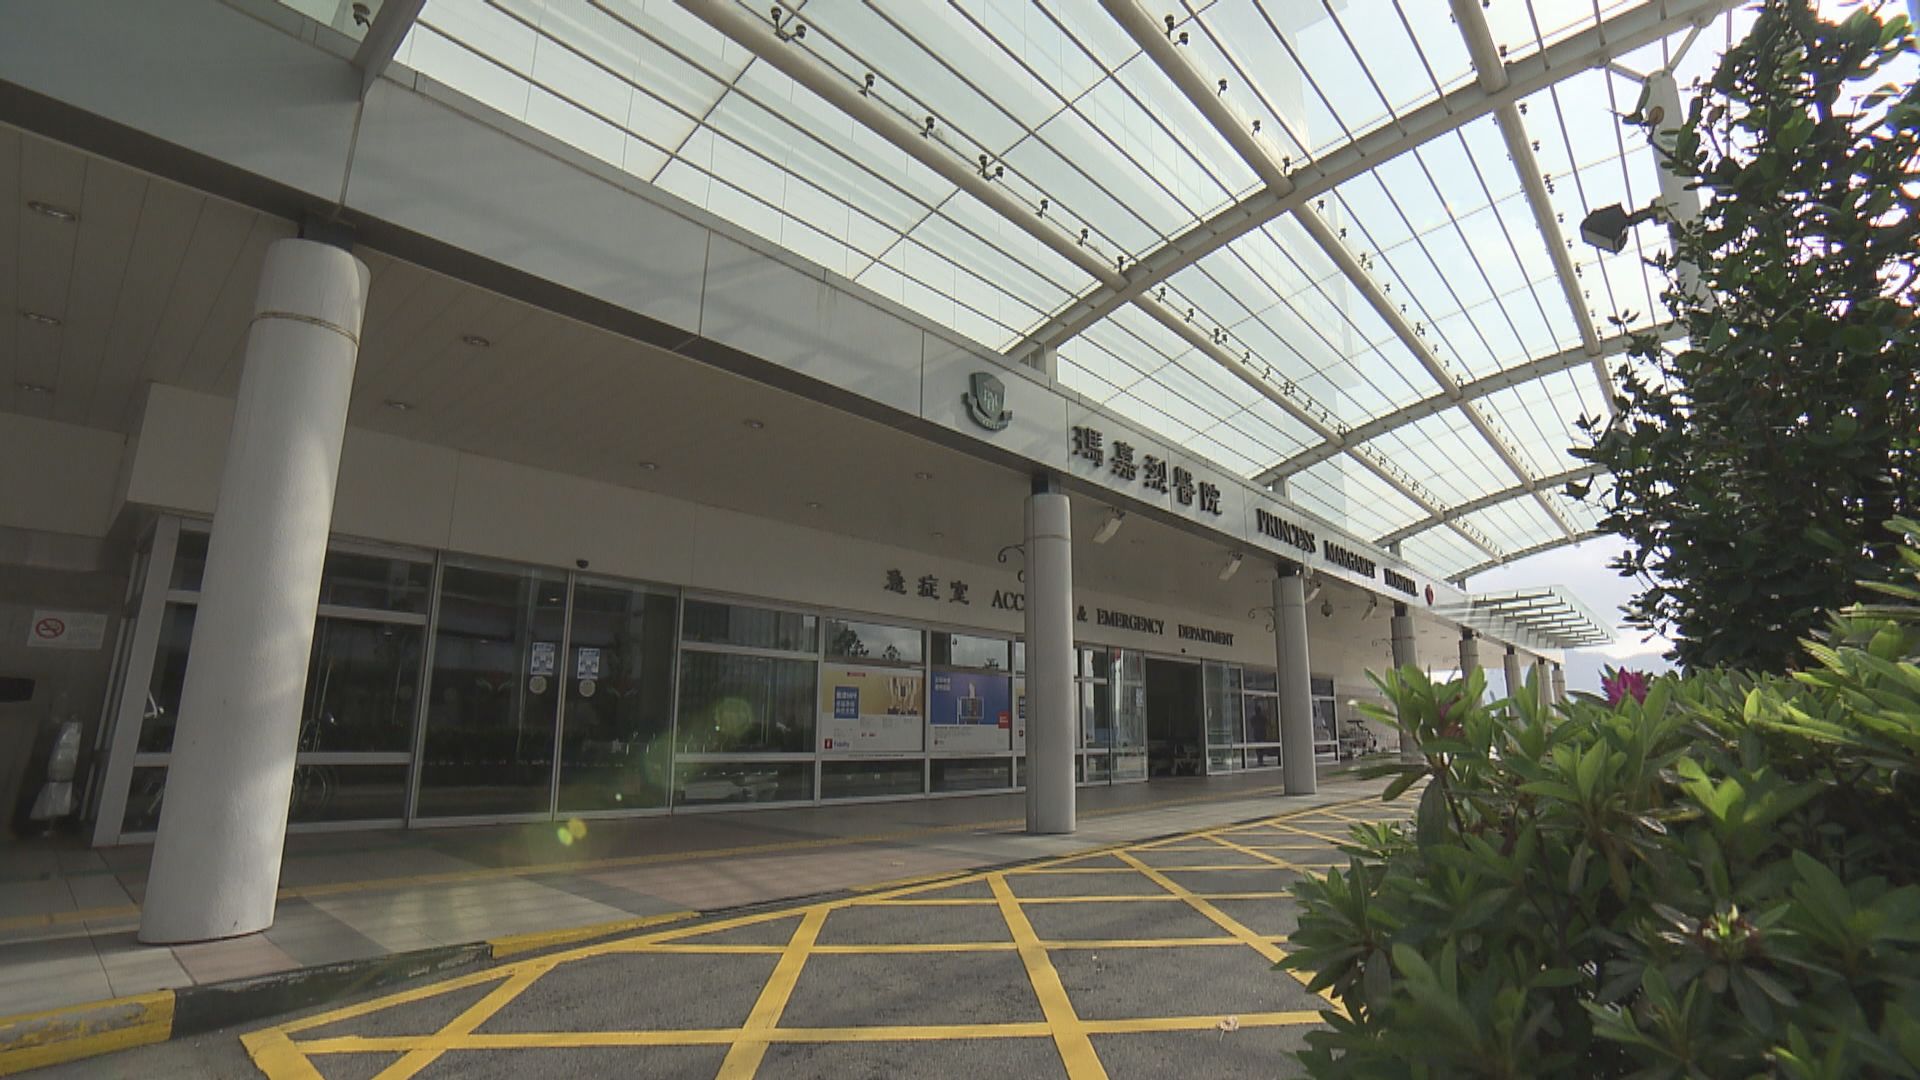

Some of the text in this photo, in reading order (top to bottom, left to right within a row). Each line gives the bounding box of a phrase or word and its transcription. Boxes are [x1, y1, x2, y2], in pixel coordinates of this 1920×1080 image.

[1072, 425, 1222, 516] 瑪嘉烈醫院
[1256, 508, 1317, 554] PRINCESS
[1323, 540, 1377, 579] MARGARET
[884, 568, 970, 606] 急症室
[1076, 605, 1088, 623] &
[1096, 608, 1165, 636] EMERGENCY
[1178, 624, 1234, 648] DEPARTMENT
